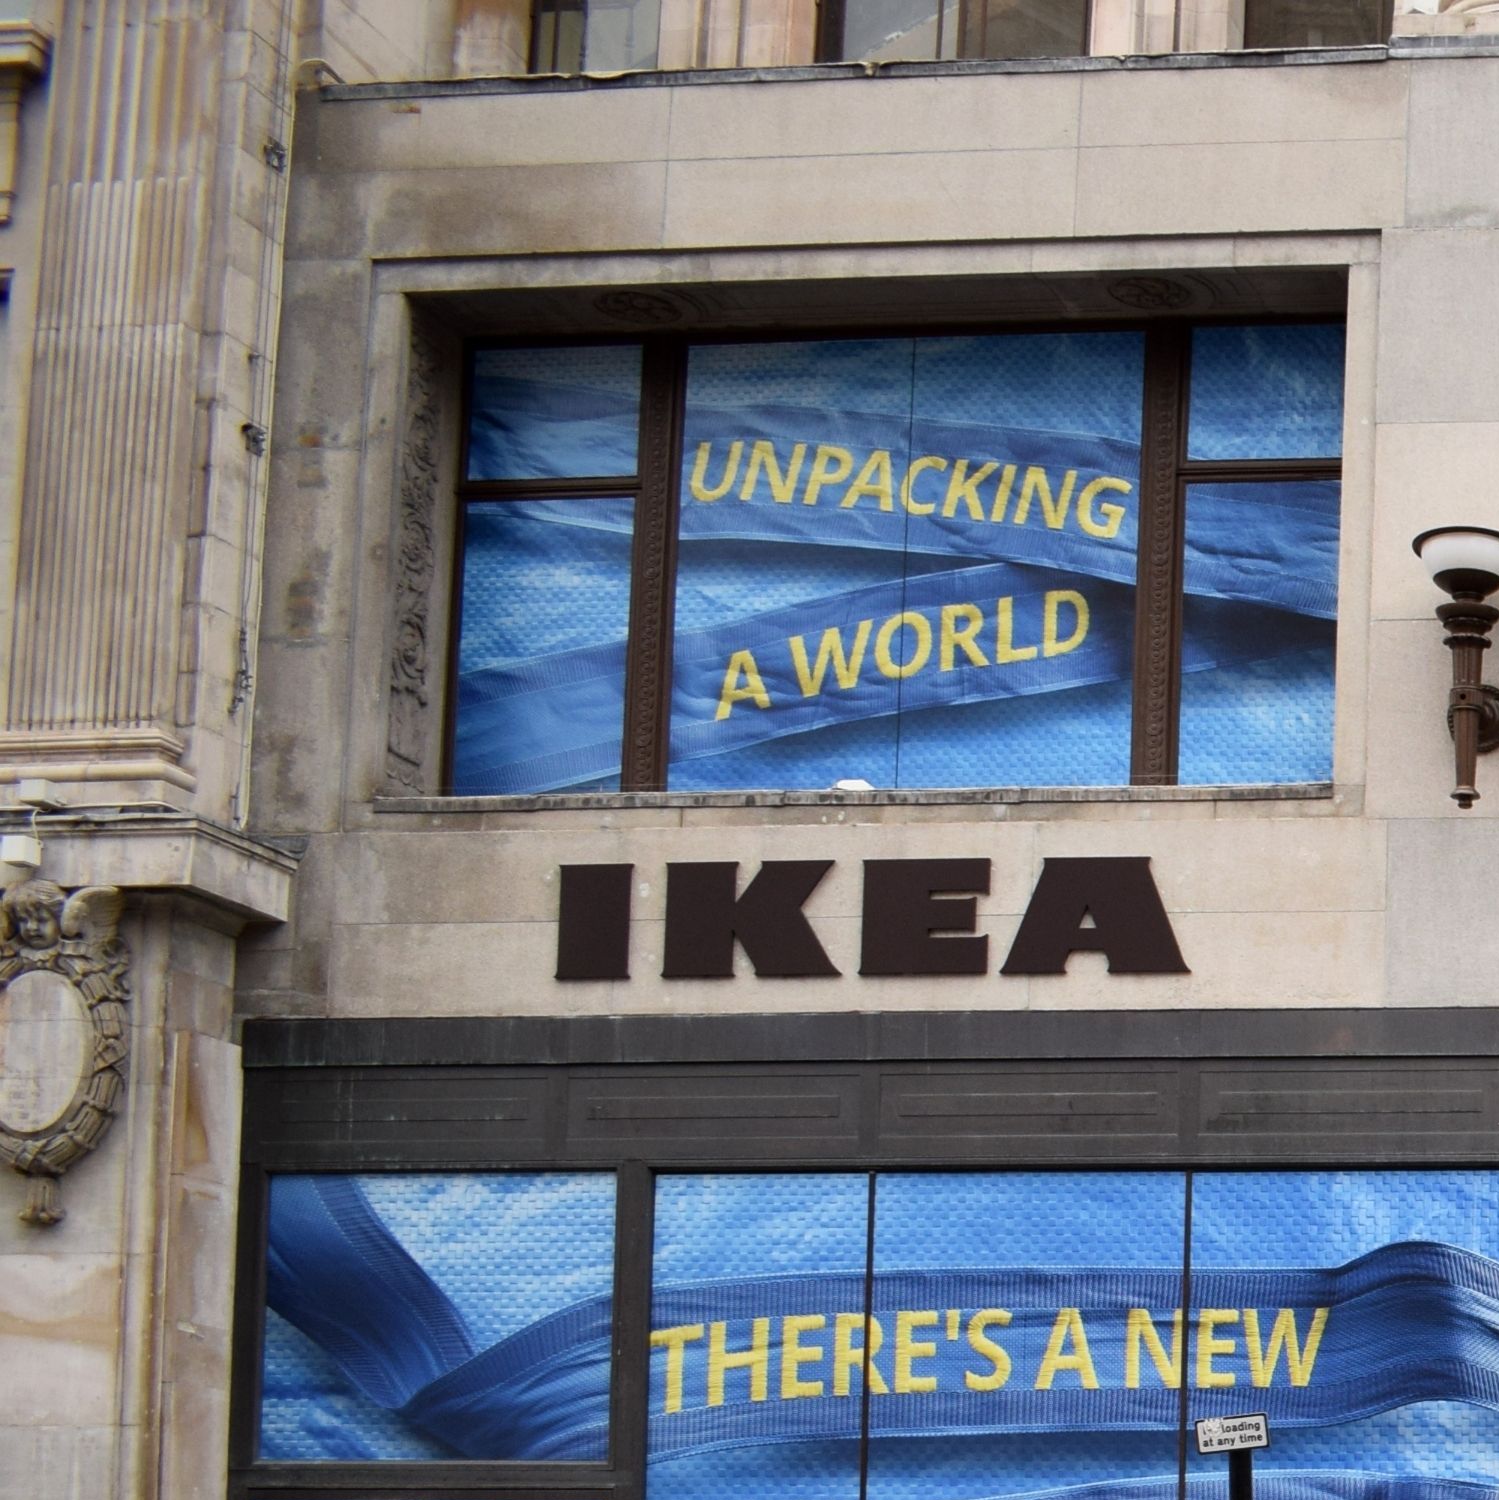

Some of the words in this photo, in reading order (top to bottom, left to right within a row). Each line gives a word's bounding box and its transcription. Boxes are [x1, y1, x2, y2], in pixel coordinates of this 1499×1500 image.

[689, 439, 1132, 540] UNPACKING
[715, 649, 770, 722] A
[788, 589, 1092, 699] WORLD
[555, 856, 1192, 981] IKEA
[650, 1308, 1013, 1414] THERE'S
[1034, 1307, 1097, 1391] A
[1126, 1307, 1330, 1390] NEW
[1203, 1438, 1214, 1448] at
[1217, 1437, 1236, 1446] any
[1239, 1433, 1263, 1444] time
[1221, 1422, 1261, 1434] loading
